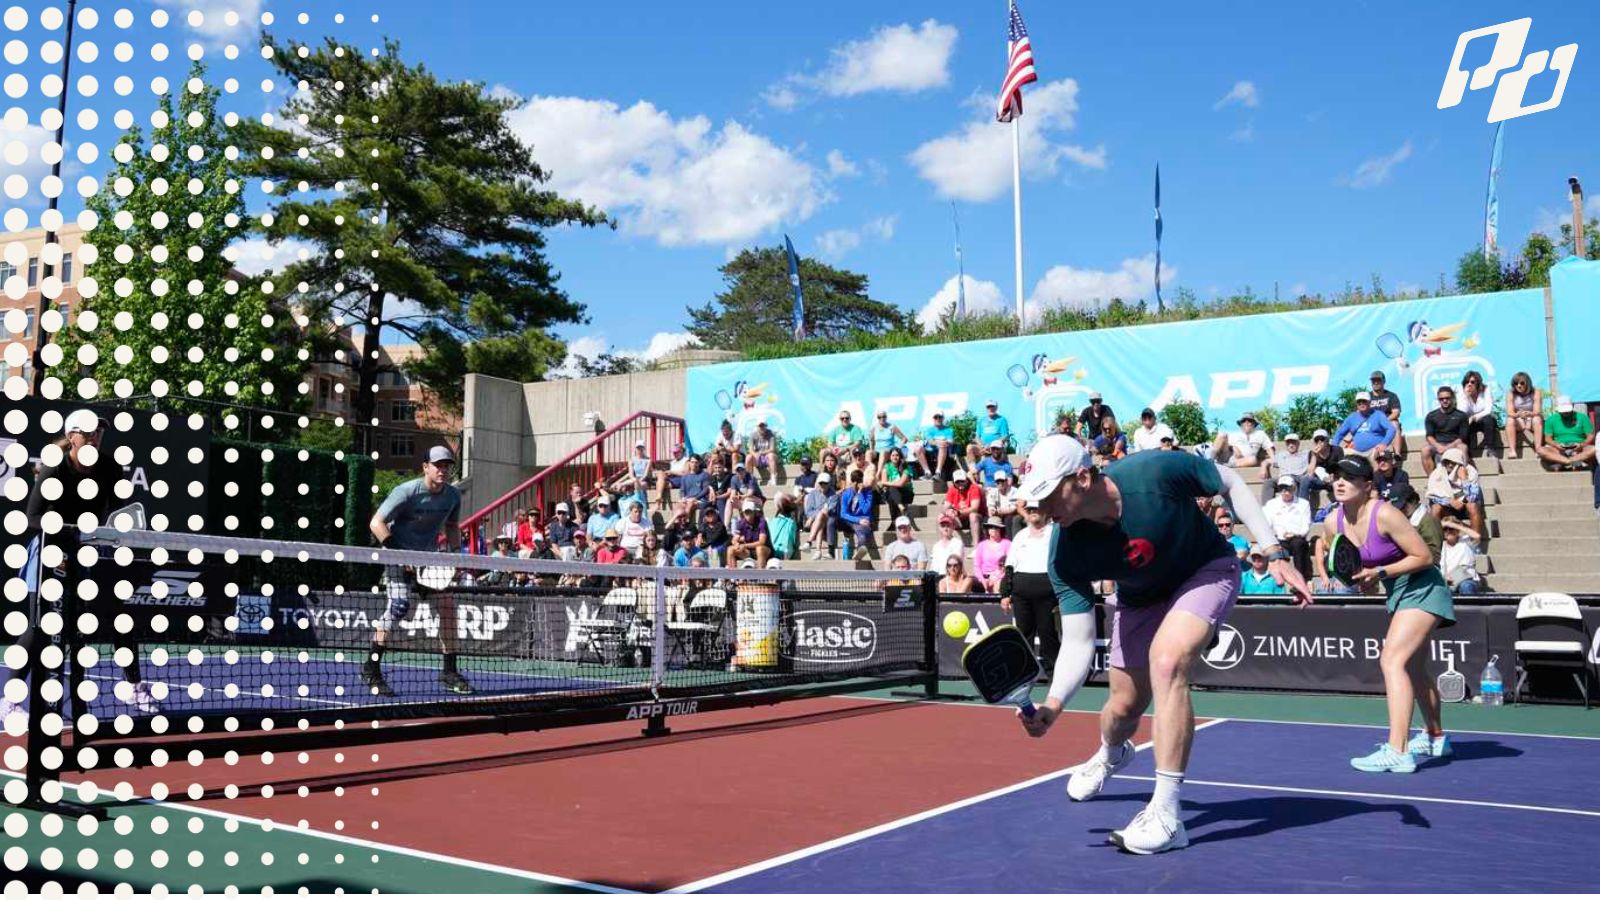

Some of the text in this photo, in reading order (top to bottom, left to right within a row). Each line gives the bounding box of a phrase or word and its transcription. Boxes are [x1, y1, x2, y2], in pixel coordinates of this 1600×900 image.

[1149, 364, 1330, 413] APP
[278, 607, 371, 628] TOYOTA
[398, 603, 509, 640] ARP
[1253, 635, 1471, 662] ZIMMER BET
[626, 701, 698, 720] APP TOUR
